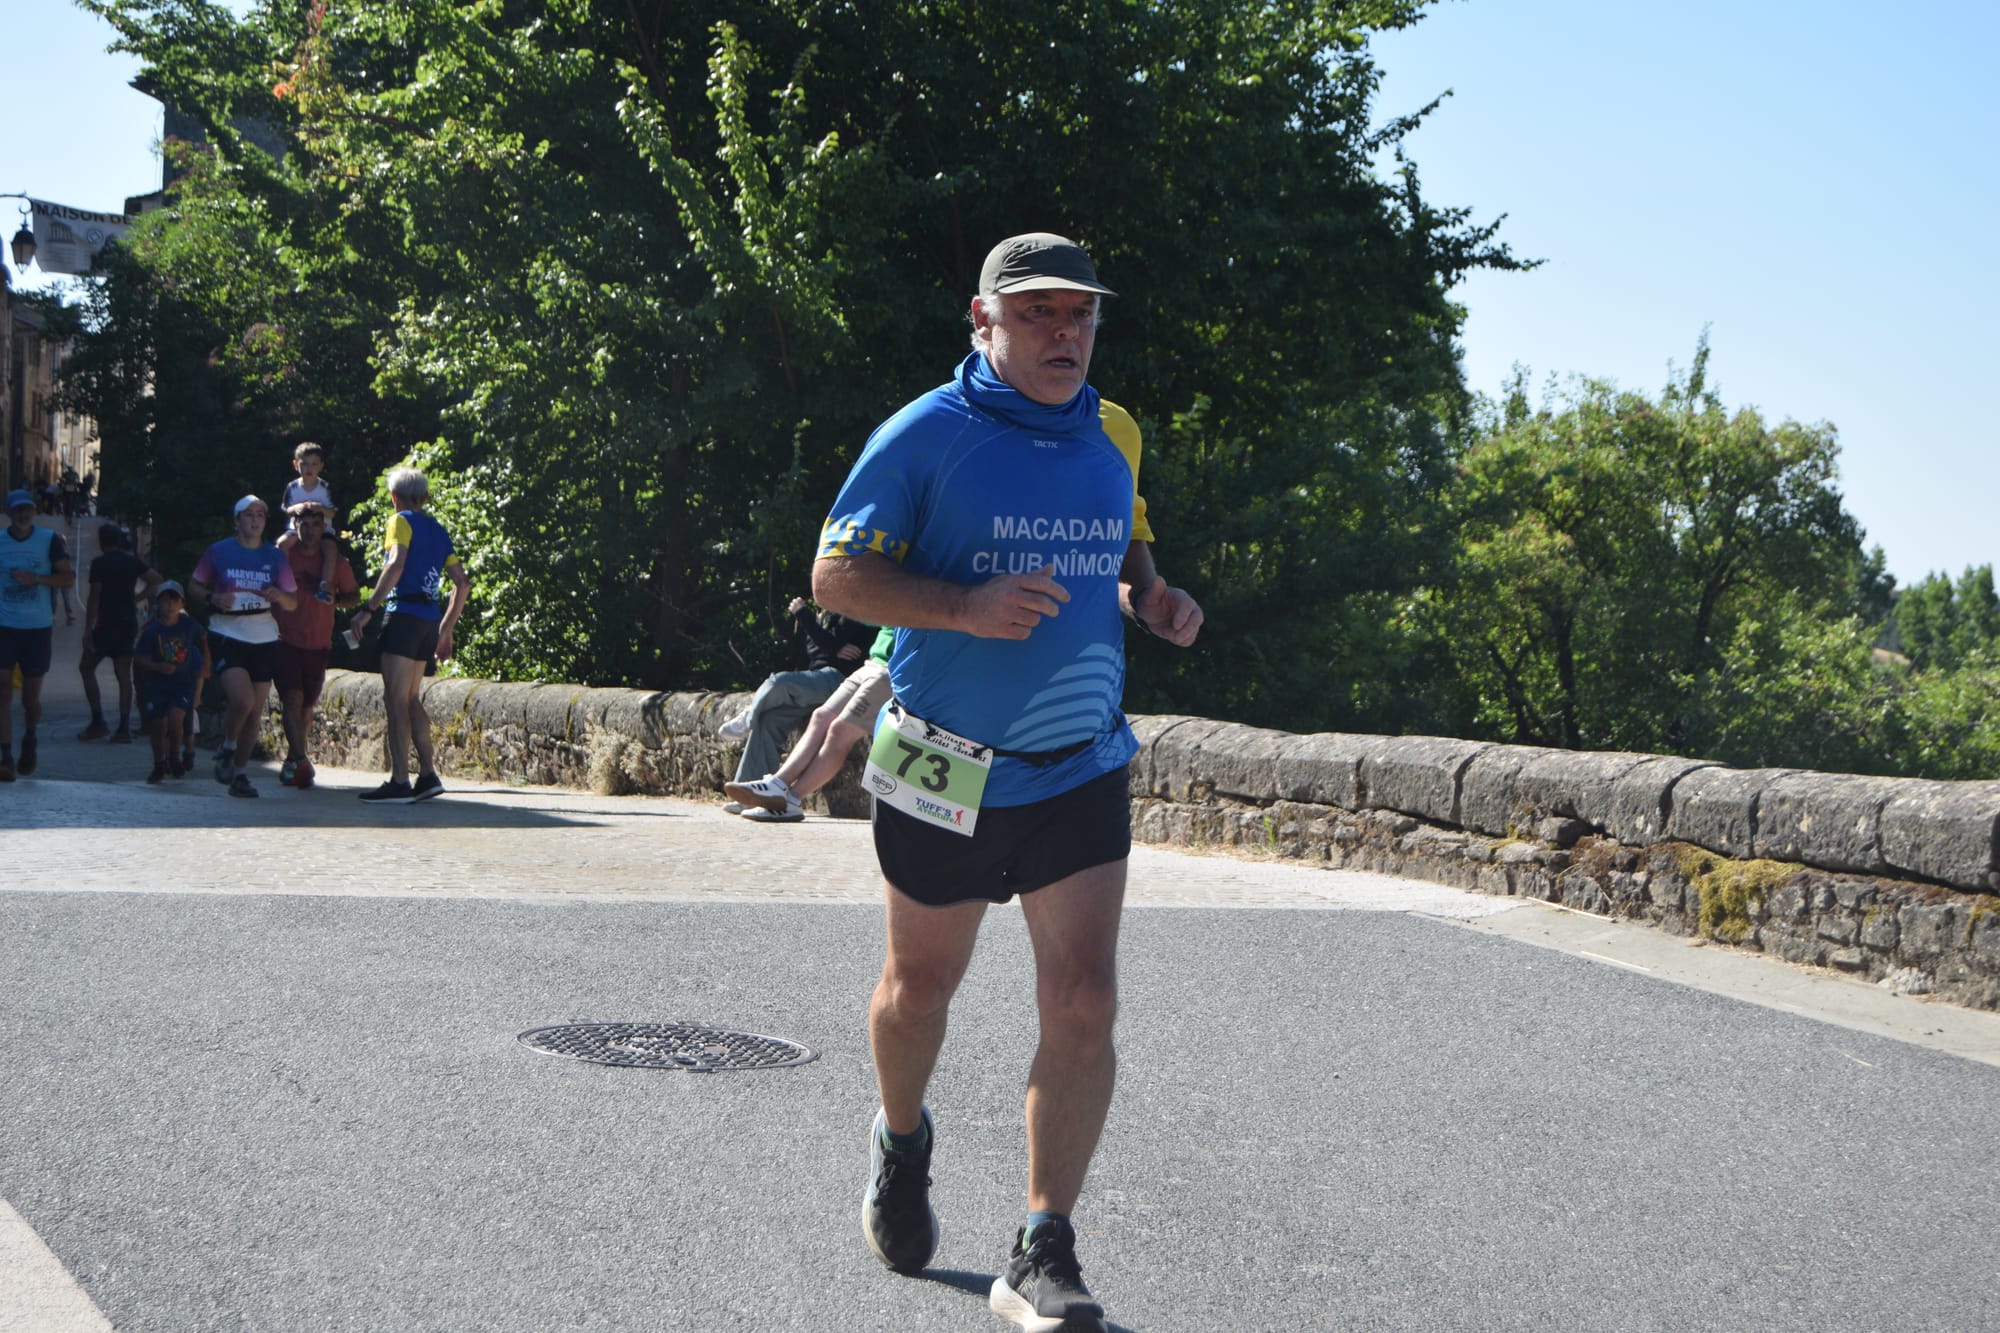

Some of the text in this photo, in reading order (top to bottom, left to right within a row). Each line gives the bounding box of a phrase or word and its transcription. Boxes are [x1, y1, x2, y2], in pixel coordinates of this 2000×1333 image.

[37, 203, 105, 223] MAISON
[1032, 439, 1059, 449] TACTIC
[993, 516, 1123, 541] MACADAM
[972, 549, 1123, 576] CLUB NÎMOIS
[897, 739, 951, 793] 73
[872, 774, 893, 790] BFP
[915, 797, 952, 817] TUFF'S
